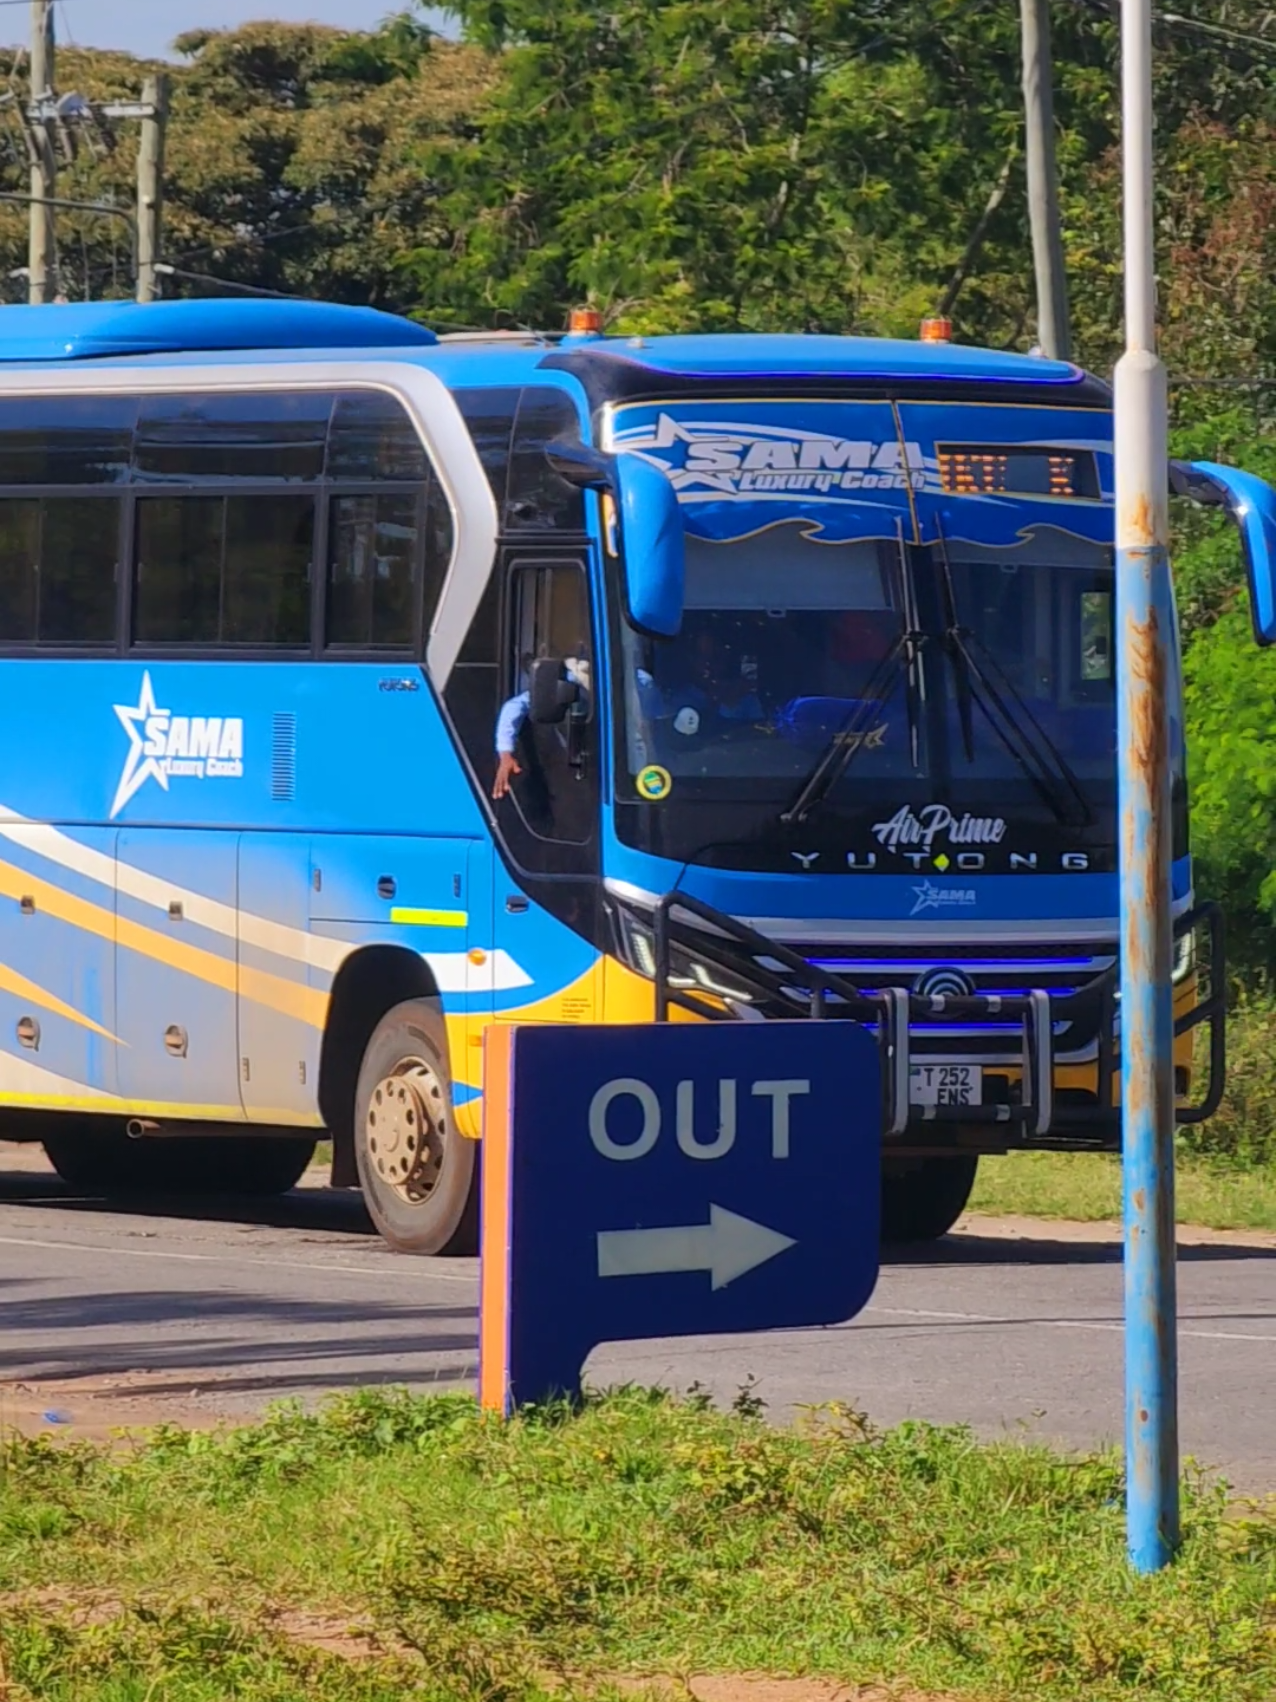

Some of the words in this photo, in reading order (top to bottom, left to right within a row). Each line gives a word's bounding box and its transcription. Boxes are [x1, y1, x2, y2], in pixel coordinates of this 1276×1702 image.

[685, 440, 925, 471] SAMA
[739, 471, 833, 493] Luxury
[840, 470, 925, 490] Coach
[144, 716, 243, 758] SAMA
[791, 851, 1089, 870] YUTONG
[926, 888, 976, 901] SAMA
[923, 1067, 934, 1087] T
[938, 1067, 970, 1087] 252
[588, 1077, 811, 1161] OUT
